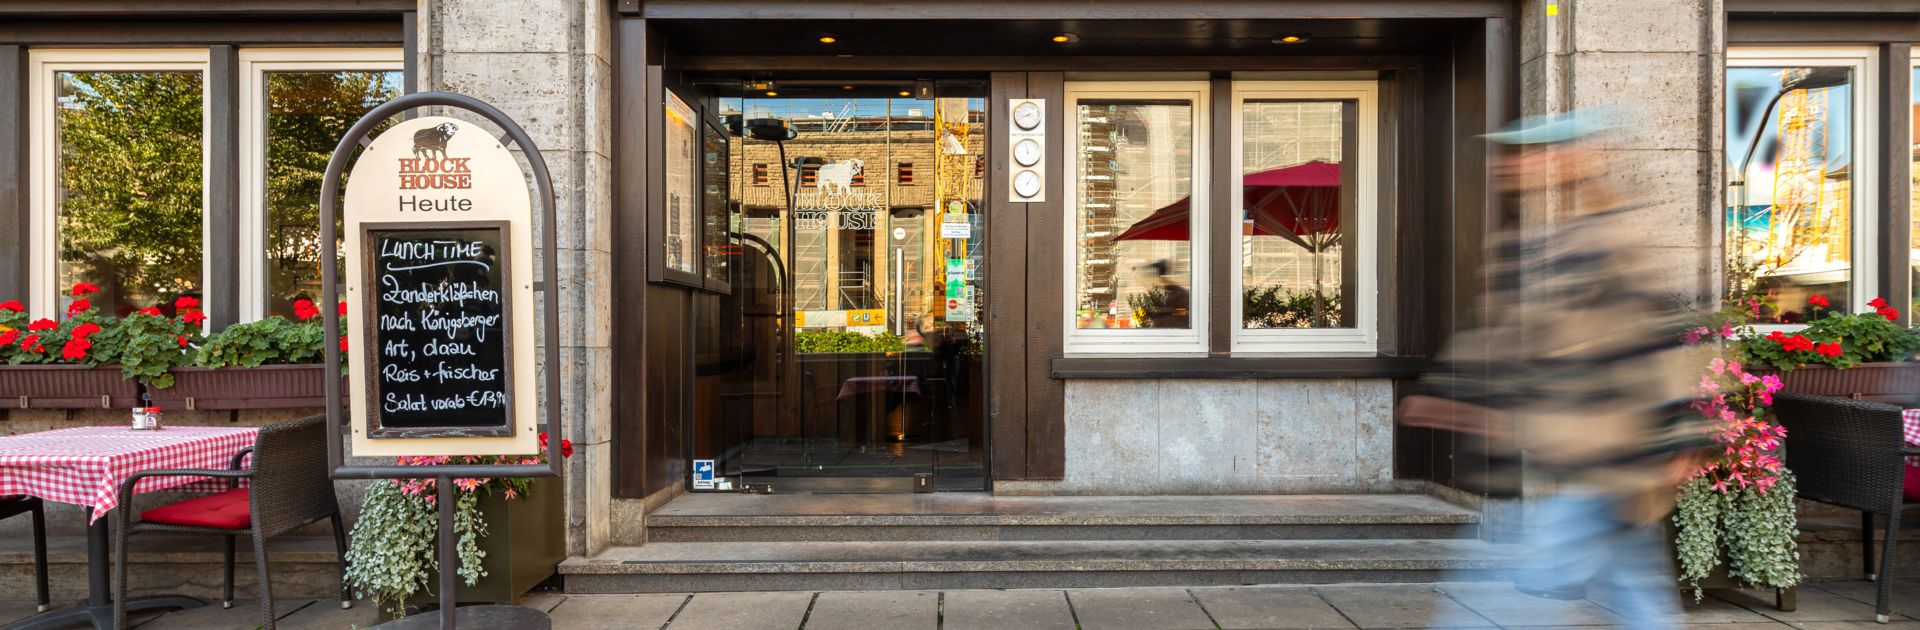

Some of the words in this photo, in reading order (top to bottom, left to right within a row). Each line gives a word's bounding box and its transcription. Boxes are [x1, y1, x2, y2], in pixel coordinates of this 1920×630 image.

[398, 157, 472, 174] BLOCK
[398, 173, 472, 190] HOUSE
[399, 195, 473, 212] Heute
[794, 192, 883, 212] BLOCK
[794, 211, 883, 230] HOUSE
[381, 239, 434, 260] LUNCH
[433, 241, 483, 258] TIME
[381, 310, 416, 332] nach
[421, 309, 500, 342] Königsberger
[385, 339, 416, 362] Art,
[423, 338, 476, 356] dazu
[383, 363, 420, 383] Reis
[432, 361, 499, 384] frischer
[384, 392, 427, 413] Salat
